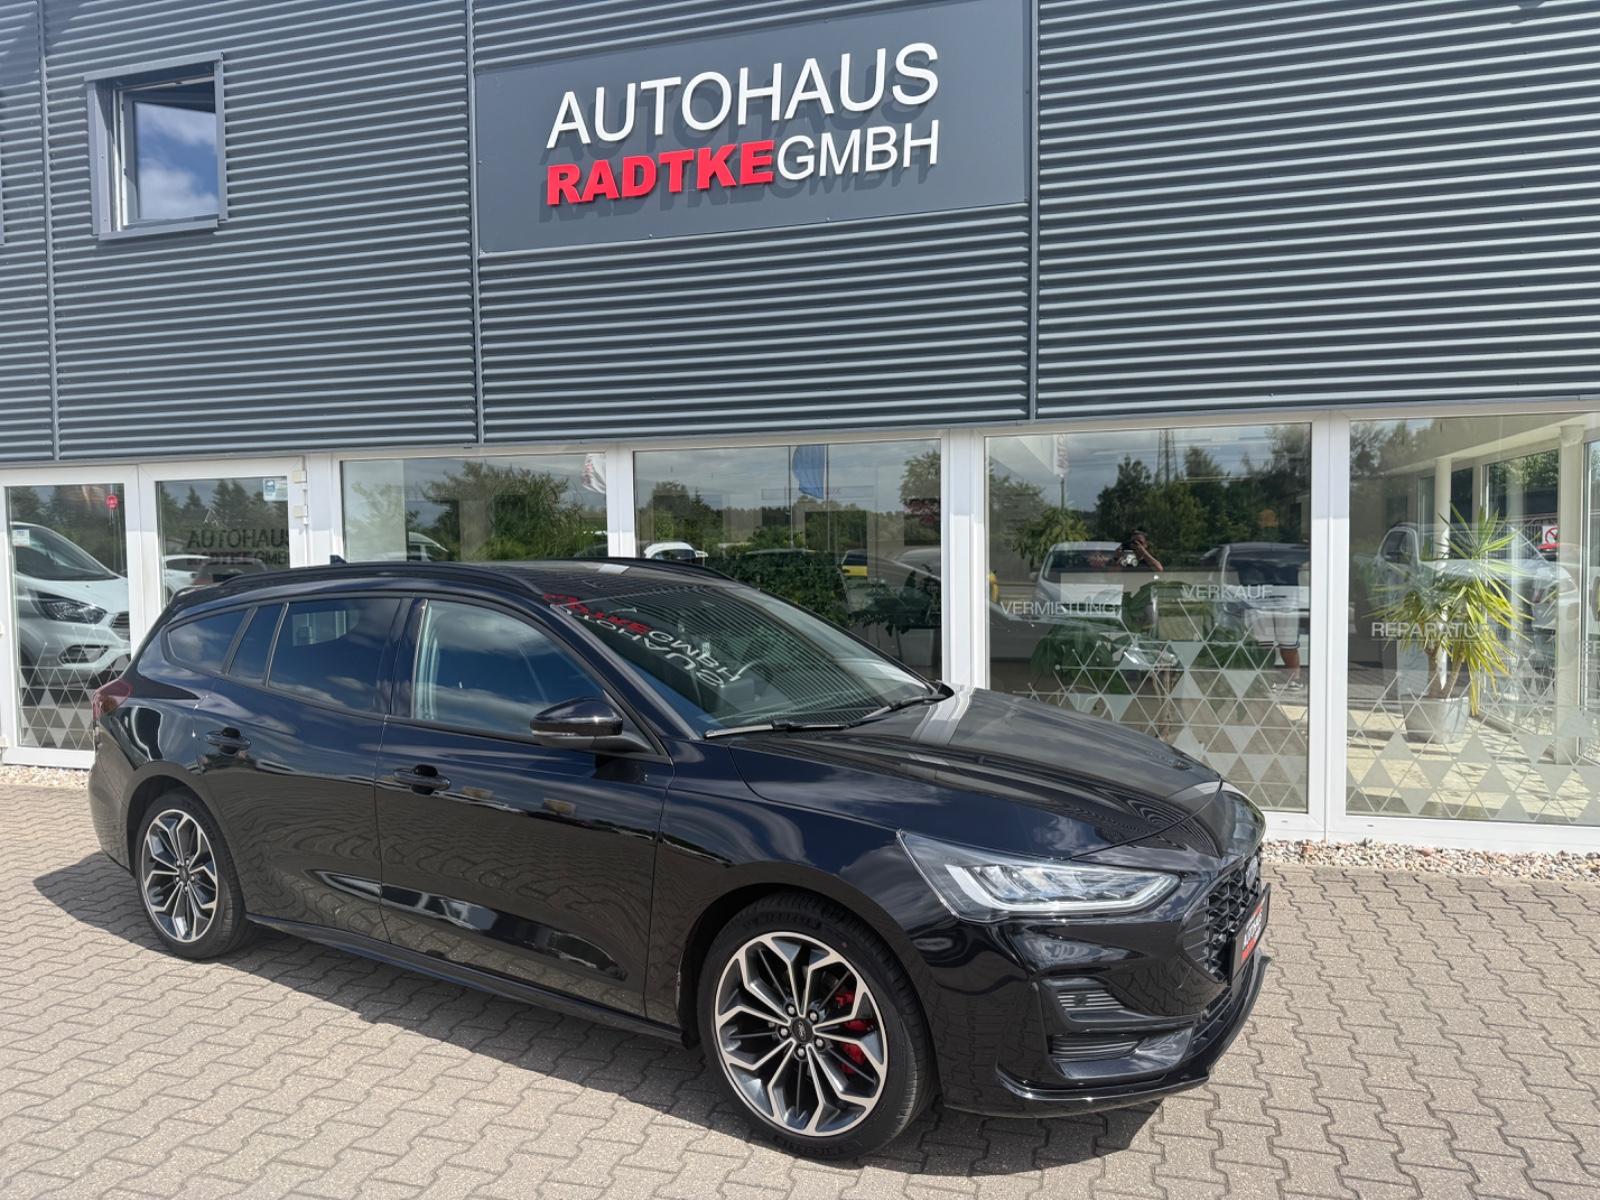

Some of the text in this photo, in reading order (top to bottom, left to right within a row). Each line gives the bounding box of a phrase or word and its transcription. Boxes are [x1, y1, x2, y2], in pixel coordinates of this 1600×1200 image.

[546, 42, 939, 149] AUTOHAUS
[1182, 584, 1274, 600] VERKAUF
[1000, 600, 1117, 616] VERMIETUNG
